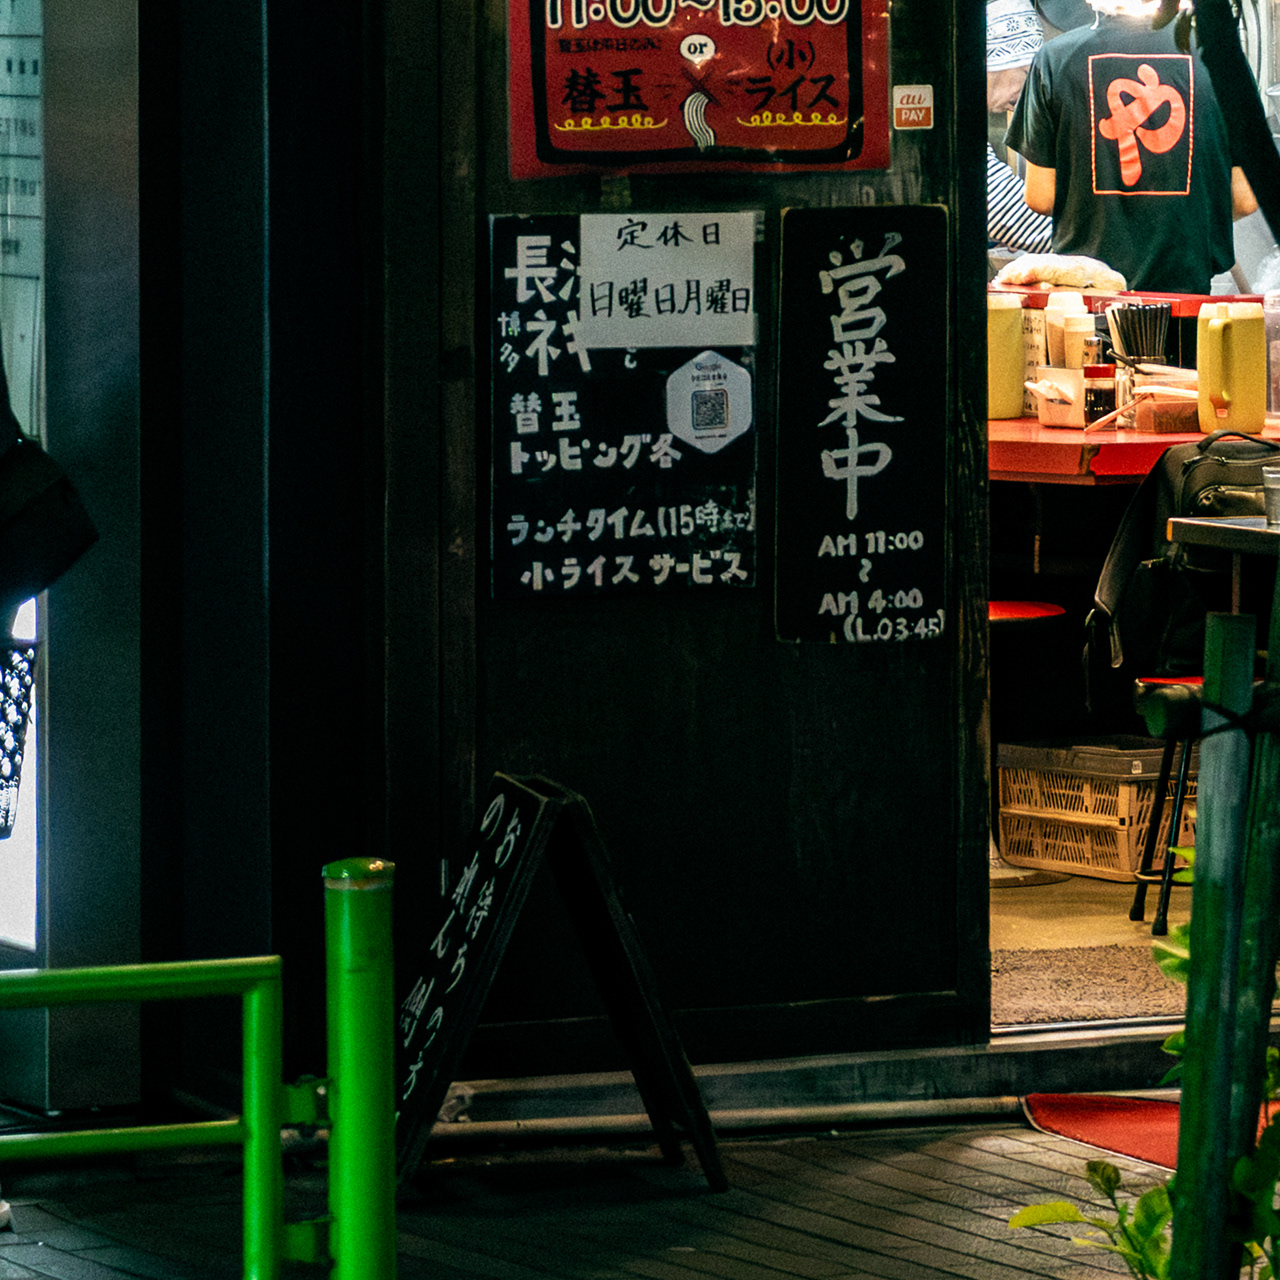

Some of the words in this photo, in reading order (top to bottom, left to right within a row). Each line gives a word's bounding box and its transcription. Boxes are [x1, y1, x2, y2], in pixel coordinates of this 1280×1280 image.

[686, 40, 708, 56] or
[562, 67, 650, 114] 替玉
[745, 72, 840, 112] ライス
[900, 93, 927, 106] au
[901, 109, 926, 121] PAY
[616, 218, 721, 251] 定休日
[817, 232, 906, 520] 営業中
[509, 391, 582, 434] 替玉
[509, 433, 683, 475] トッピング各
[818, 533, 859, 558] AM
[865, 530, 924, 554] 11:00
[818, 590, 859, 617] AM
[867, 588, 924, 614] 4:00
